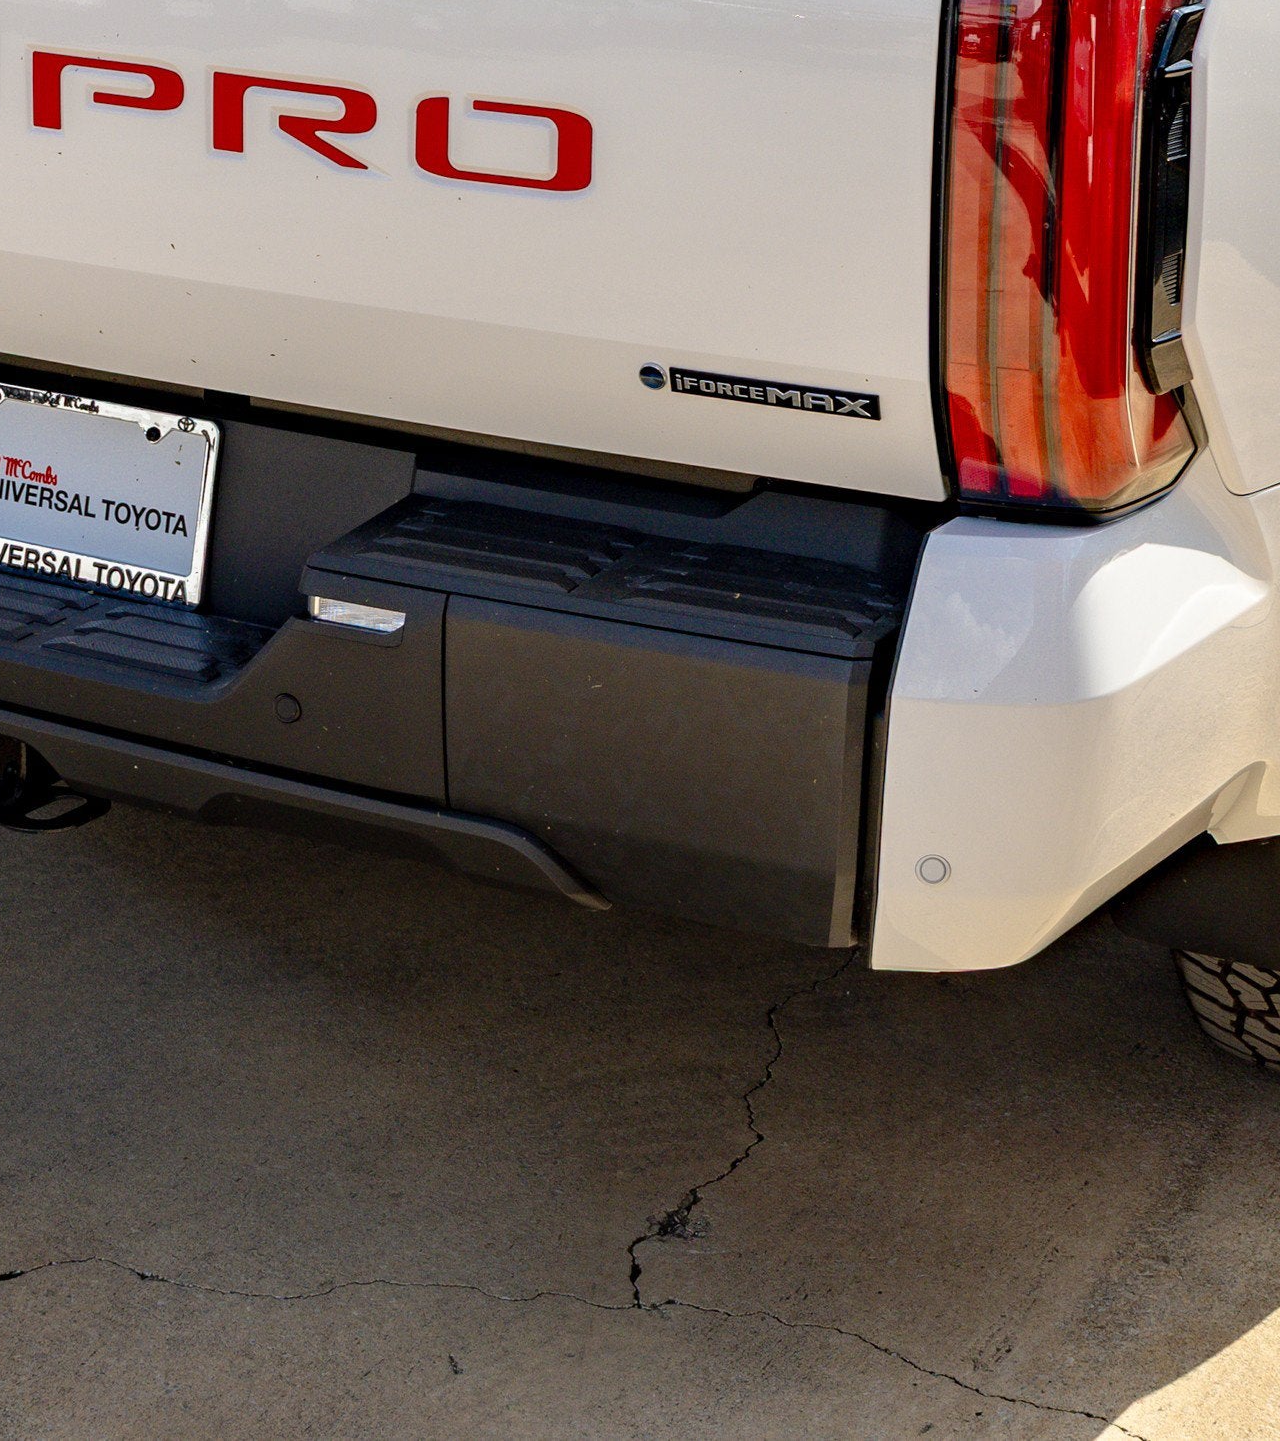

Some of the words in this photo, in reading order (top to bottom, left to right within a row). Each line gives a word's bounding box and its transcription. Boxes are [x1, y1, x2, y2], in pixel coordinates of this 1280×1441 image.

[31, 49, 593, 193] PRO
[102, 499, 188, 538] TOYOTA
[93, 563, 188, 606] TOYOTA
